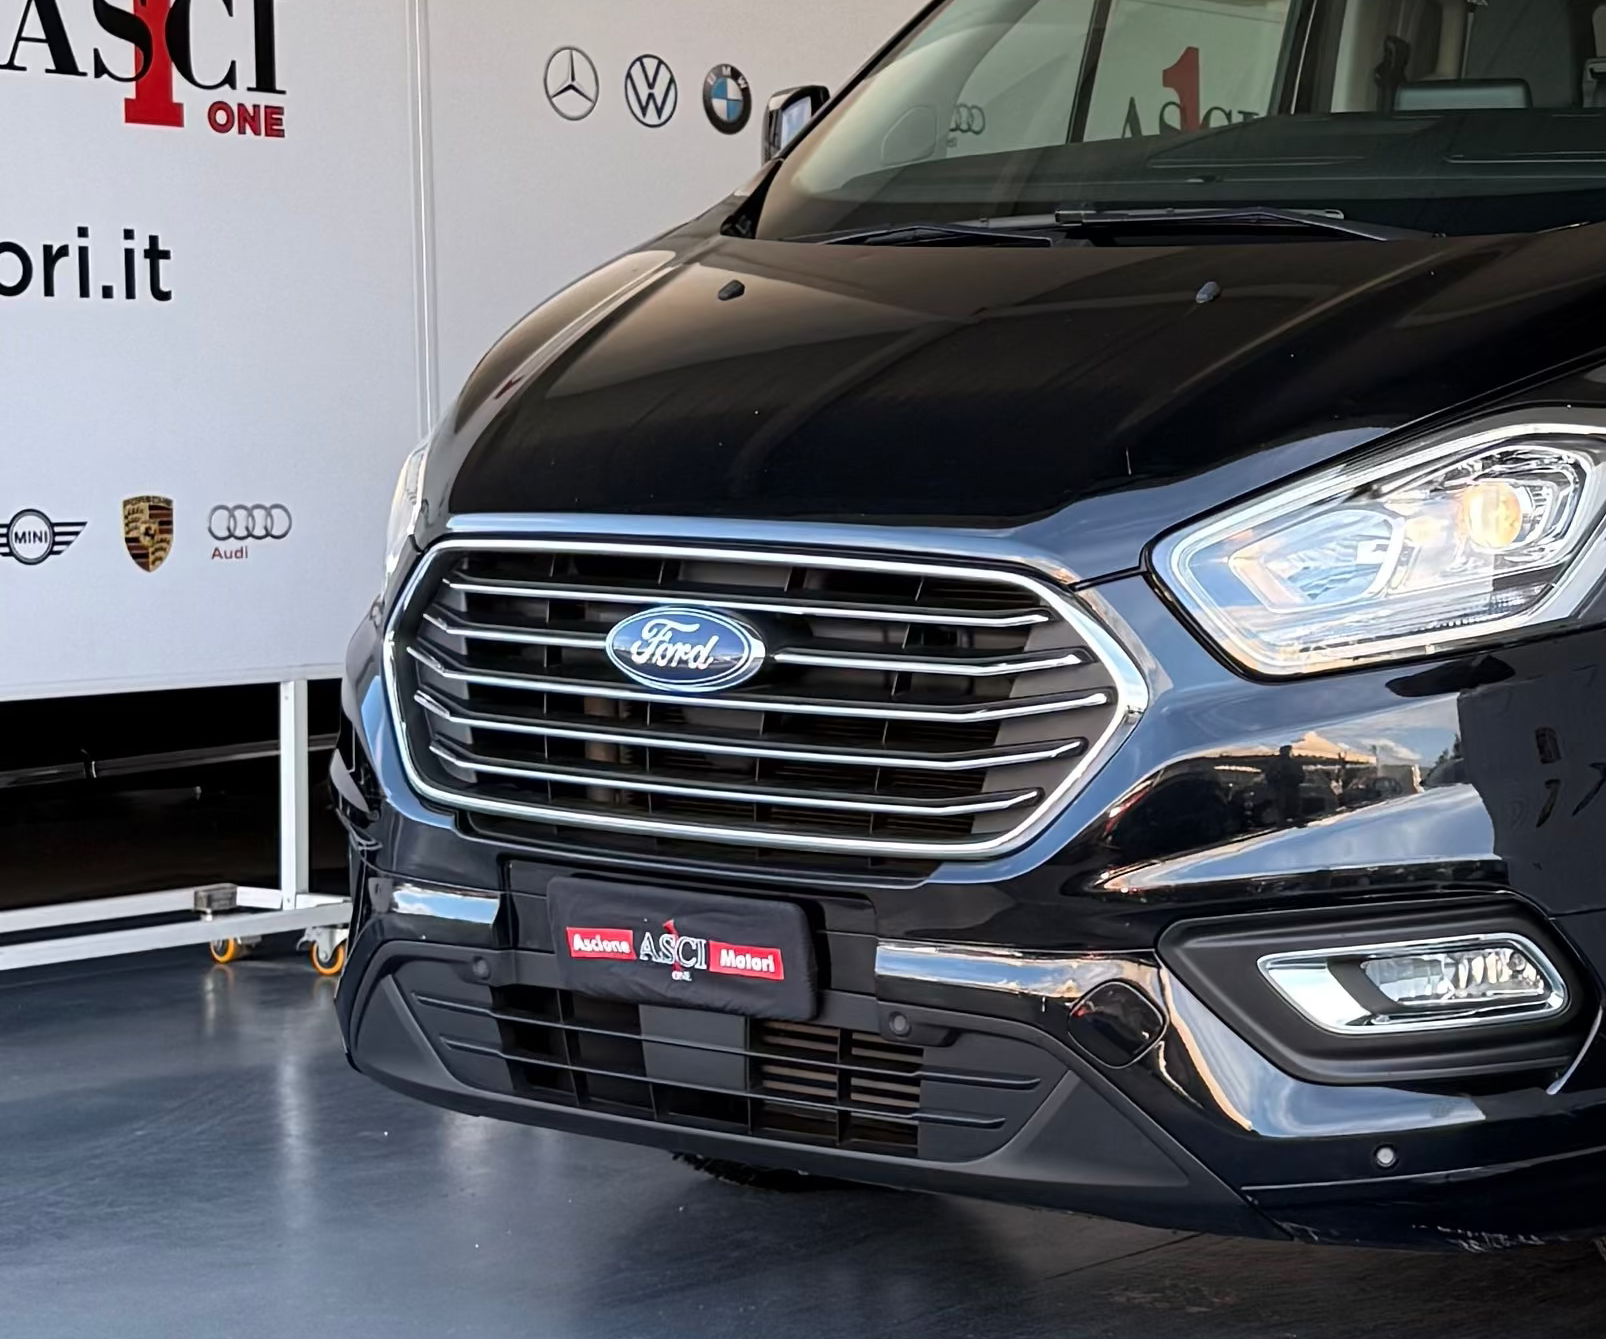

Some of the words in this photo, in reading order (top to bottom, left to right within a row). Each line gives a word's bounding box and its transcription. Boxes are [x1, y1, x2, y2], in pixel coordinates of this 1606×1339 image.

[208, 101, 285, 138] ONE
[0, 226, 172, 301] ori.it
[14, 530, 48, 544] MINI
[211, 546, 248, 560] Audi
[630, 618, 719, 669] Ford
[573, 933, 630, 954] Ascione
[639, 931, 707, 970] ASCI
[720, 949, 775, 973] Motori
